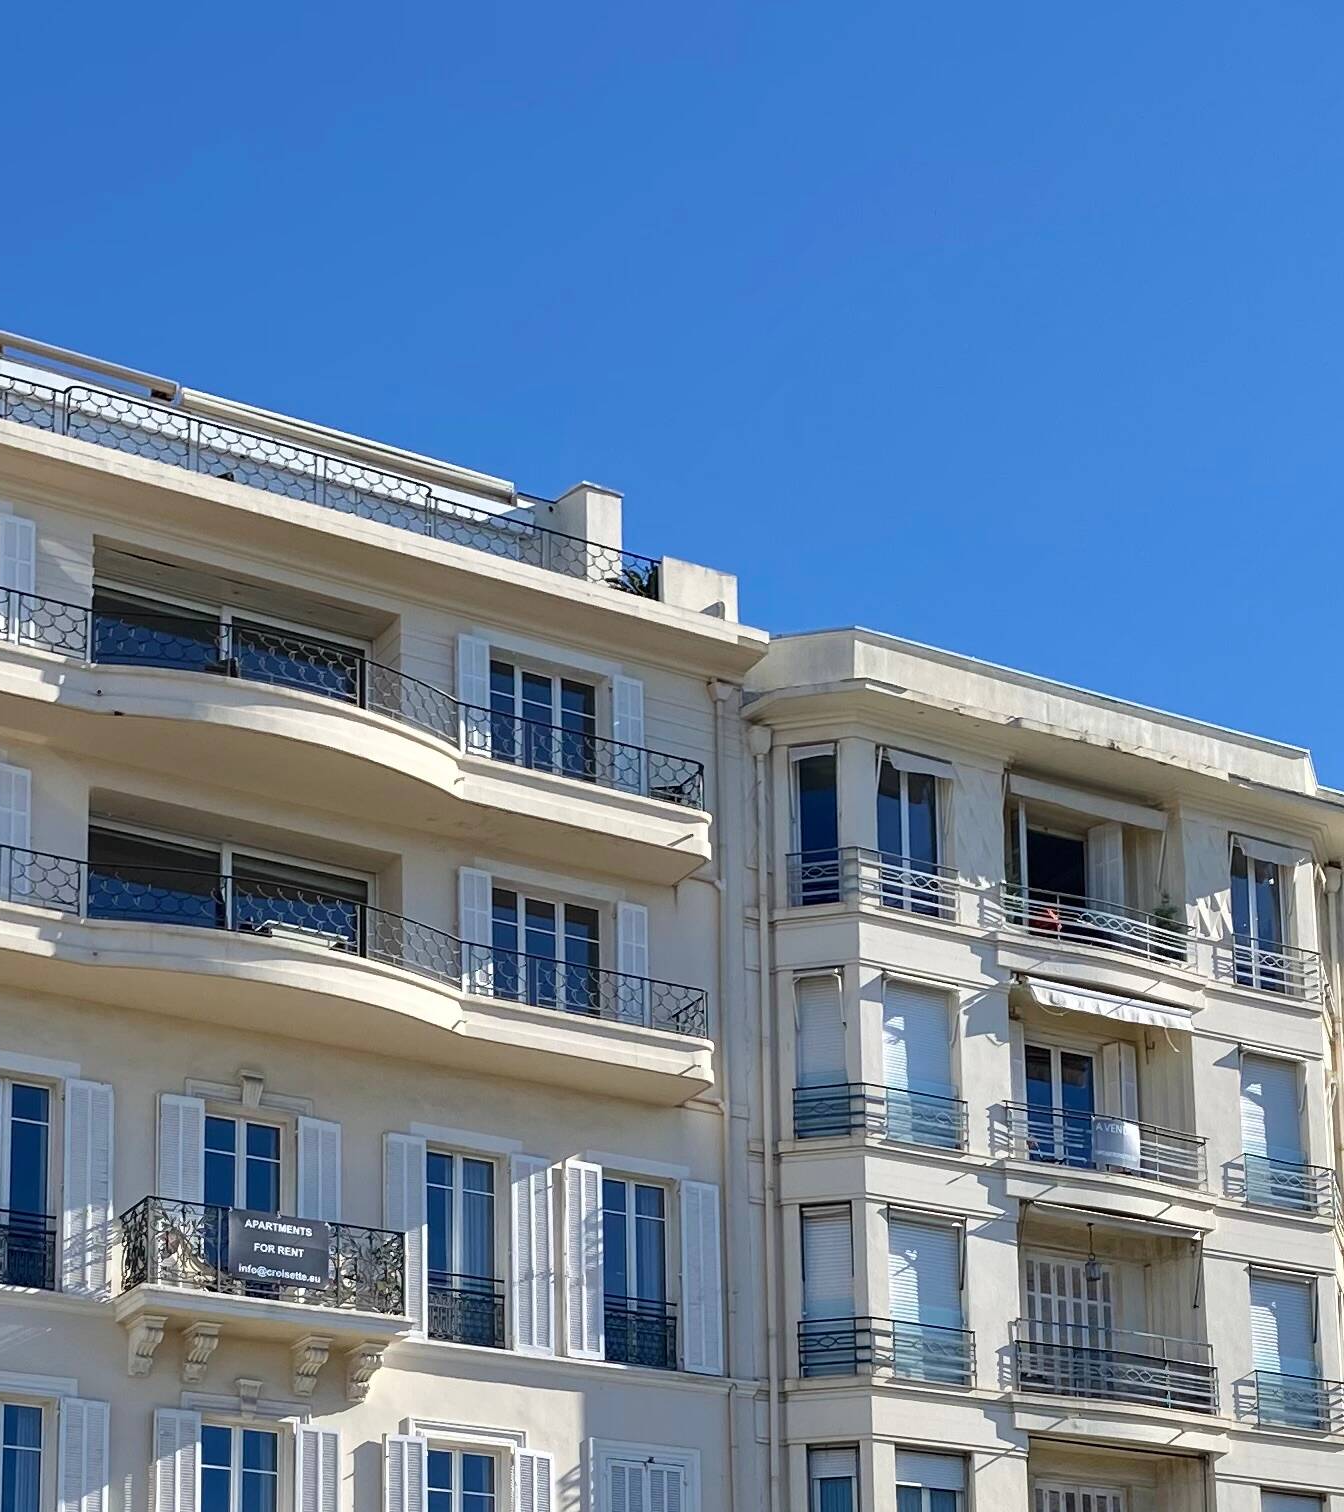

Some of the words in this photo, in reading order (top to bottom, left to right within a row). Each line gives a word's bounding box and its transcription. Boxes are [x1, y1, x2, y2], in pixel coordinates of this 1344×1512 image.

[244, 1219, 313, 1237] APARTMENTS
[253, 1242, 276, 1254] FOR
[277, 1245, 305, 1258] RENT
[238, 1263, 321, 1284] info@croisette.eu
